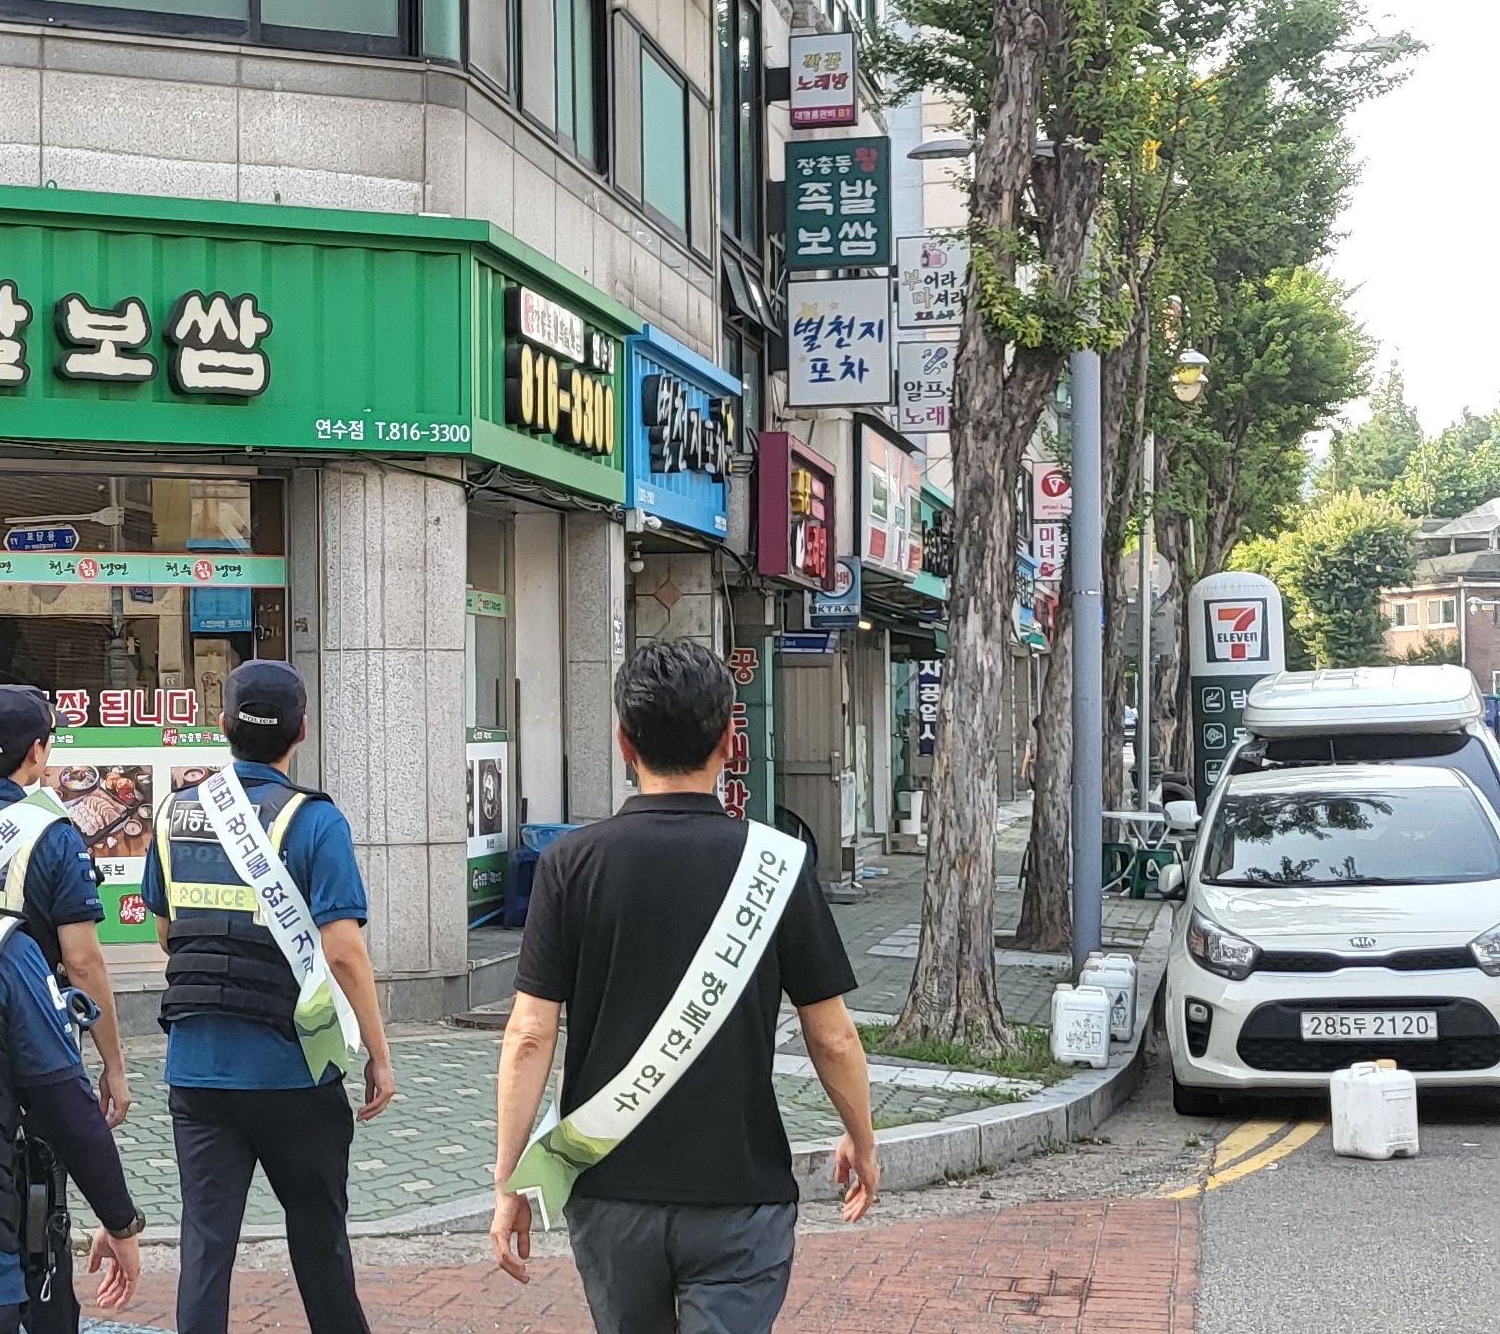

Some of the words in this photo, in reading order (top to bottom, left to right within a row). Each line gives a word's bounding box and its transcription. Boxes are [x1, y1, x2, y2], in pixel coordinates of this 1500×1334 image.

[795, 71, 850, 92] 노래방
[797, 155, 853, 176] 장충동
[797, 178, 879, 216] 족발
[797, 220, 879, 257] 보쌈
[902, 269, 958, 291] 부어라
[793, 315, 884, 353] 별천지
[808, 354, 870, 384] 포차
[520, 343, 616, 456] 816-3300
[315, 417, 364, 441] 연수점
[374, 419, 470, 443] T.816-3300
[99, 689, 199, 728] 됩니다
[242, 713, 277, 724] POLICE
[225, 813, 272, 880] 광고물
[261, 880, 302, 930] 없는
[715, 849, 788, 969] 안전하고
[1349, 936, 1376, 948] KIA
[659, 970, 728, 1062] 행복한
[1373, 1015, 1429, 1036] 2120
[613, 1063, 666, 1113] 연수
